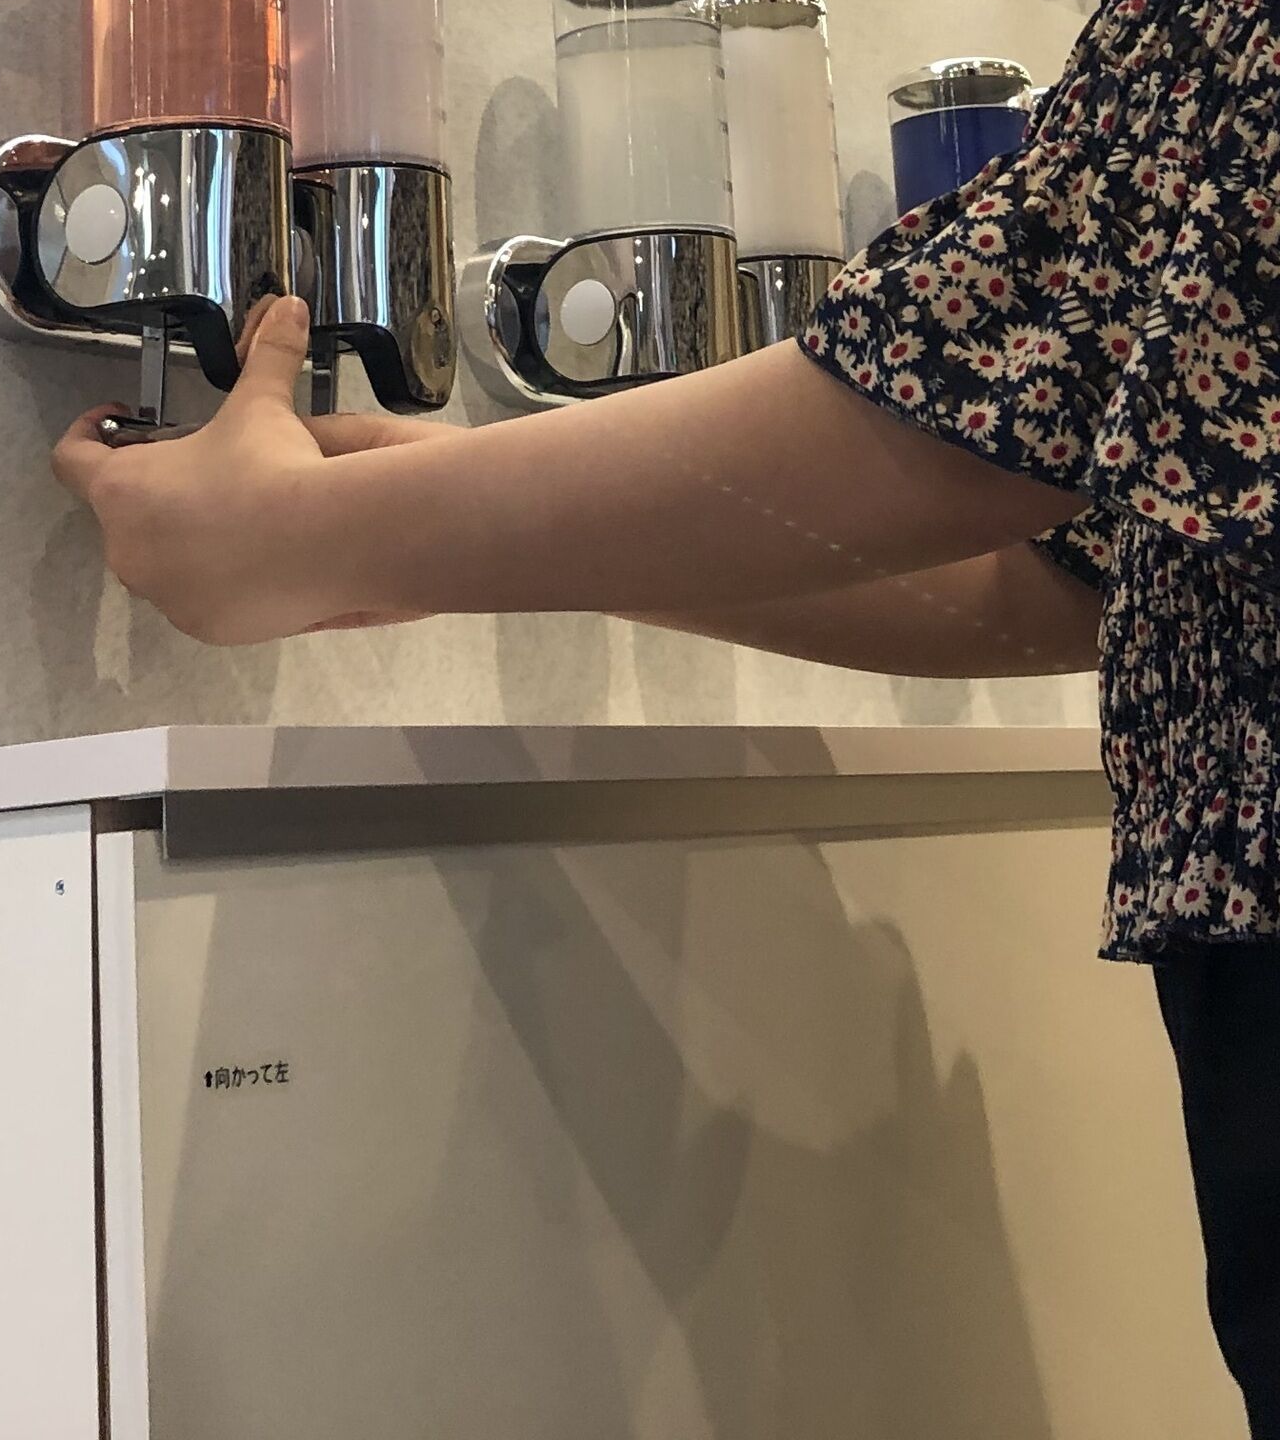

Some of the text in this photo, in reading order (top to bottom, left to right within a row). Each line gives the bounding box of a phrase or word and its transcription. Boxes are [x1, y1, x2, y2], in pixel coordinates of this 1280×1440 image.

[215, 1060, 289, 1089] 向かって左
